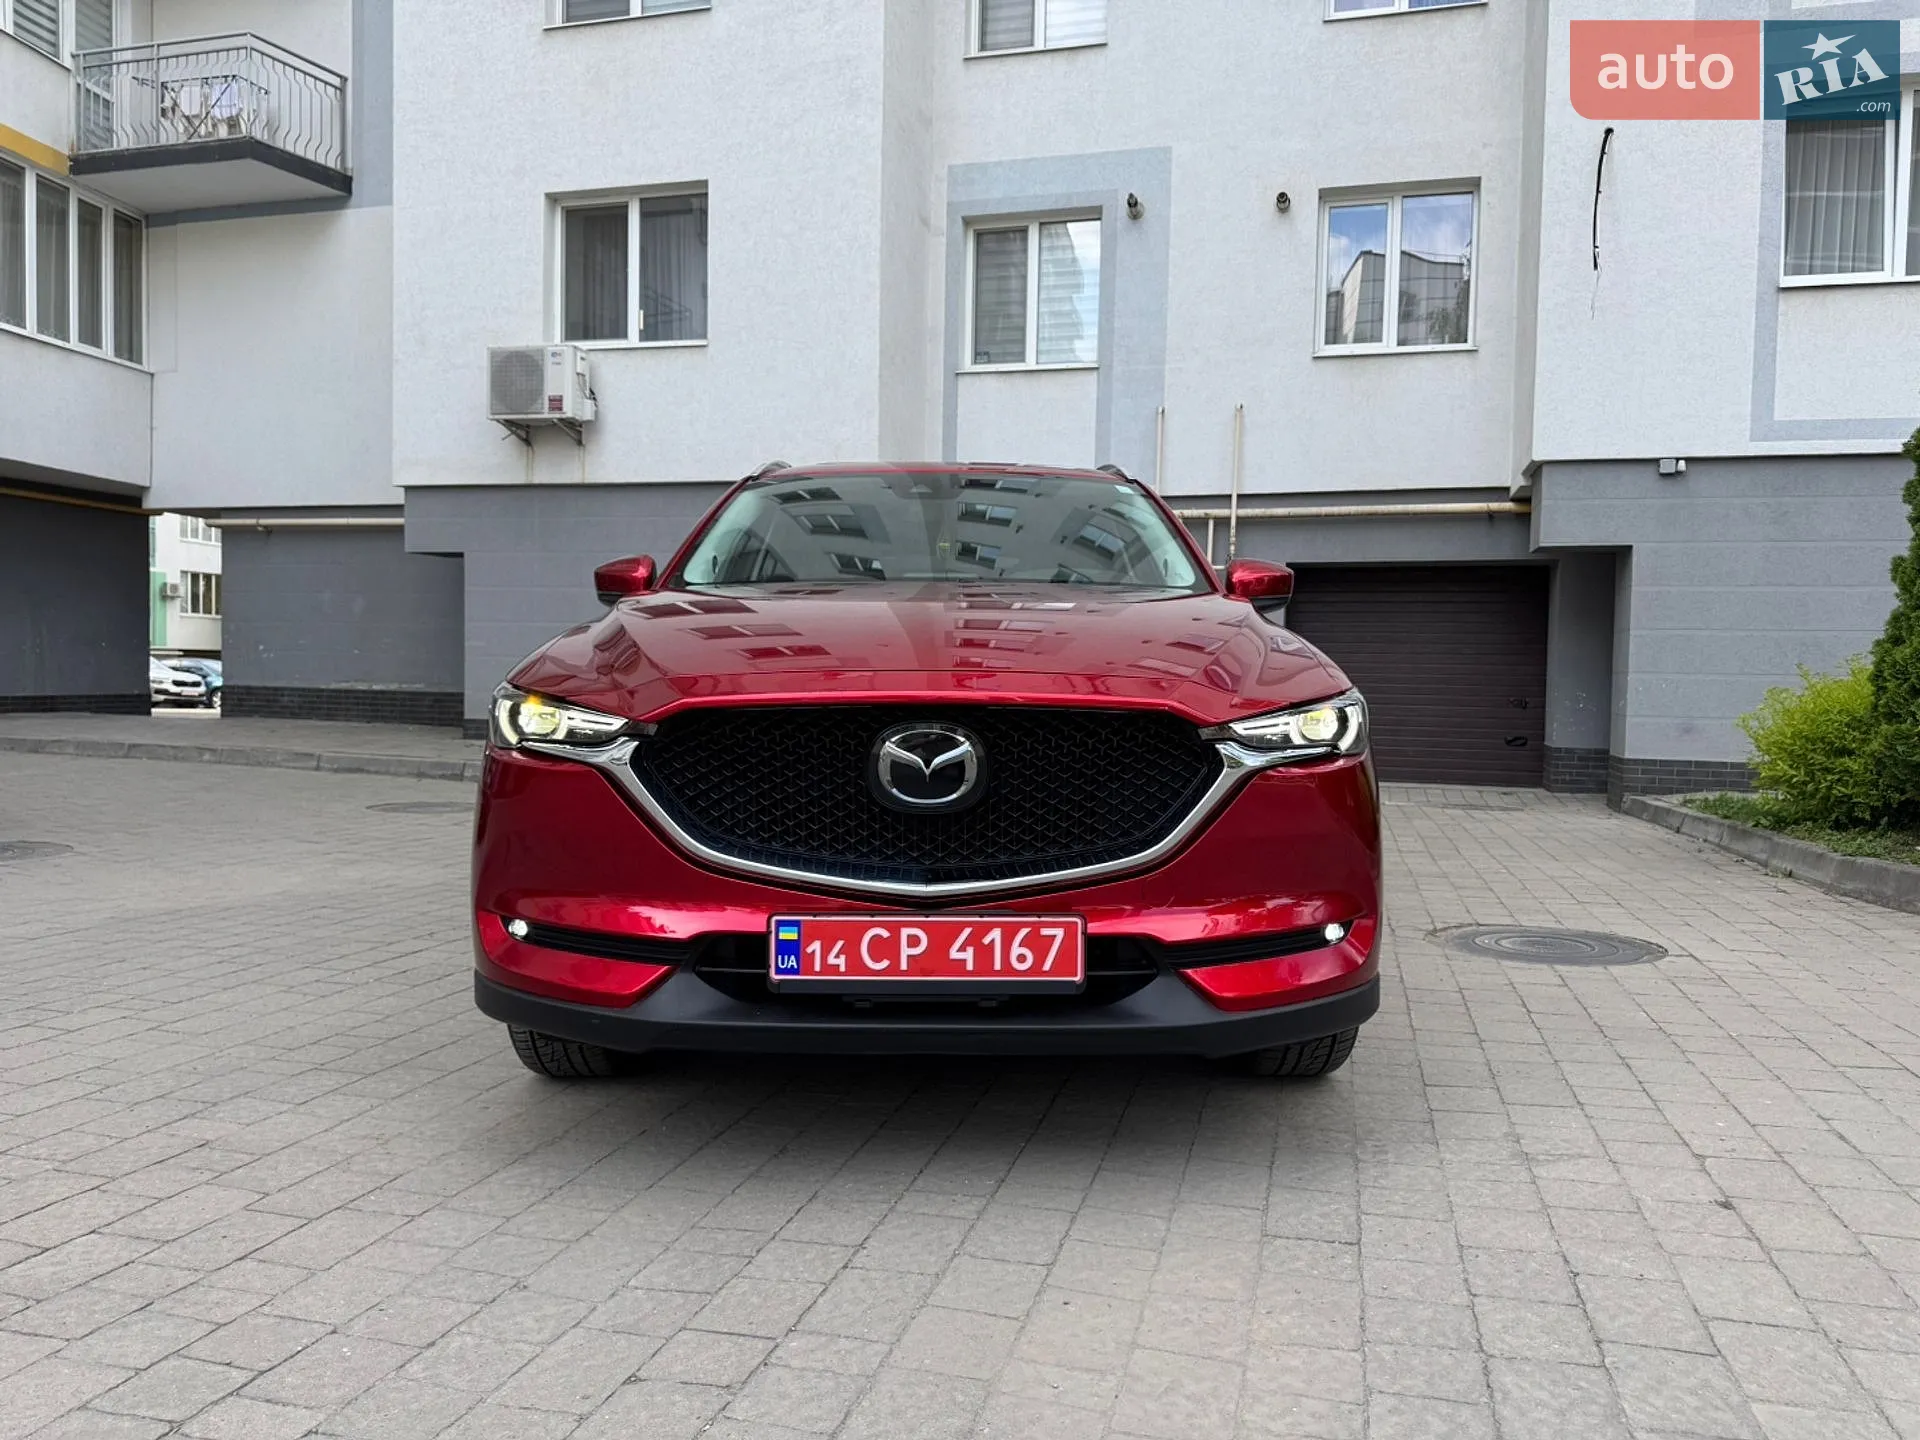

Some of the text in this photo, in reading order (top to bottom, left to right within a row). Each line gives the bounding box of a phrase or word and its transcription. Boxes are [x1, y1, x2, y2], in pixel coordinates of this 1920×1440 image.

[778, 955, 798, 969] UA
[805, 927, 1066, 972] 14 CP 4167
